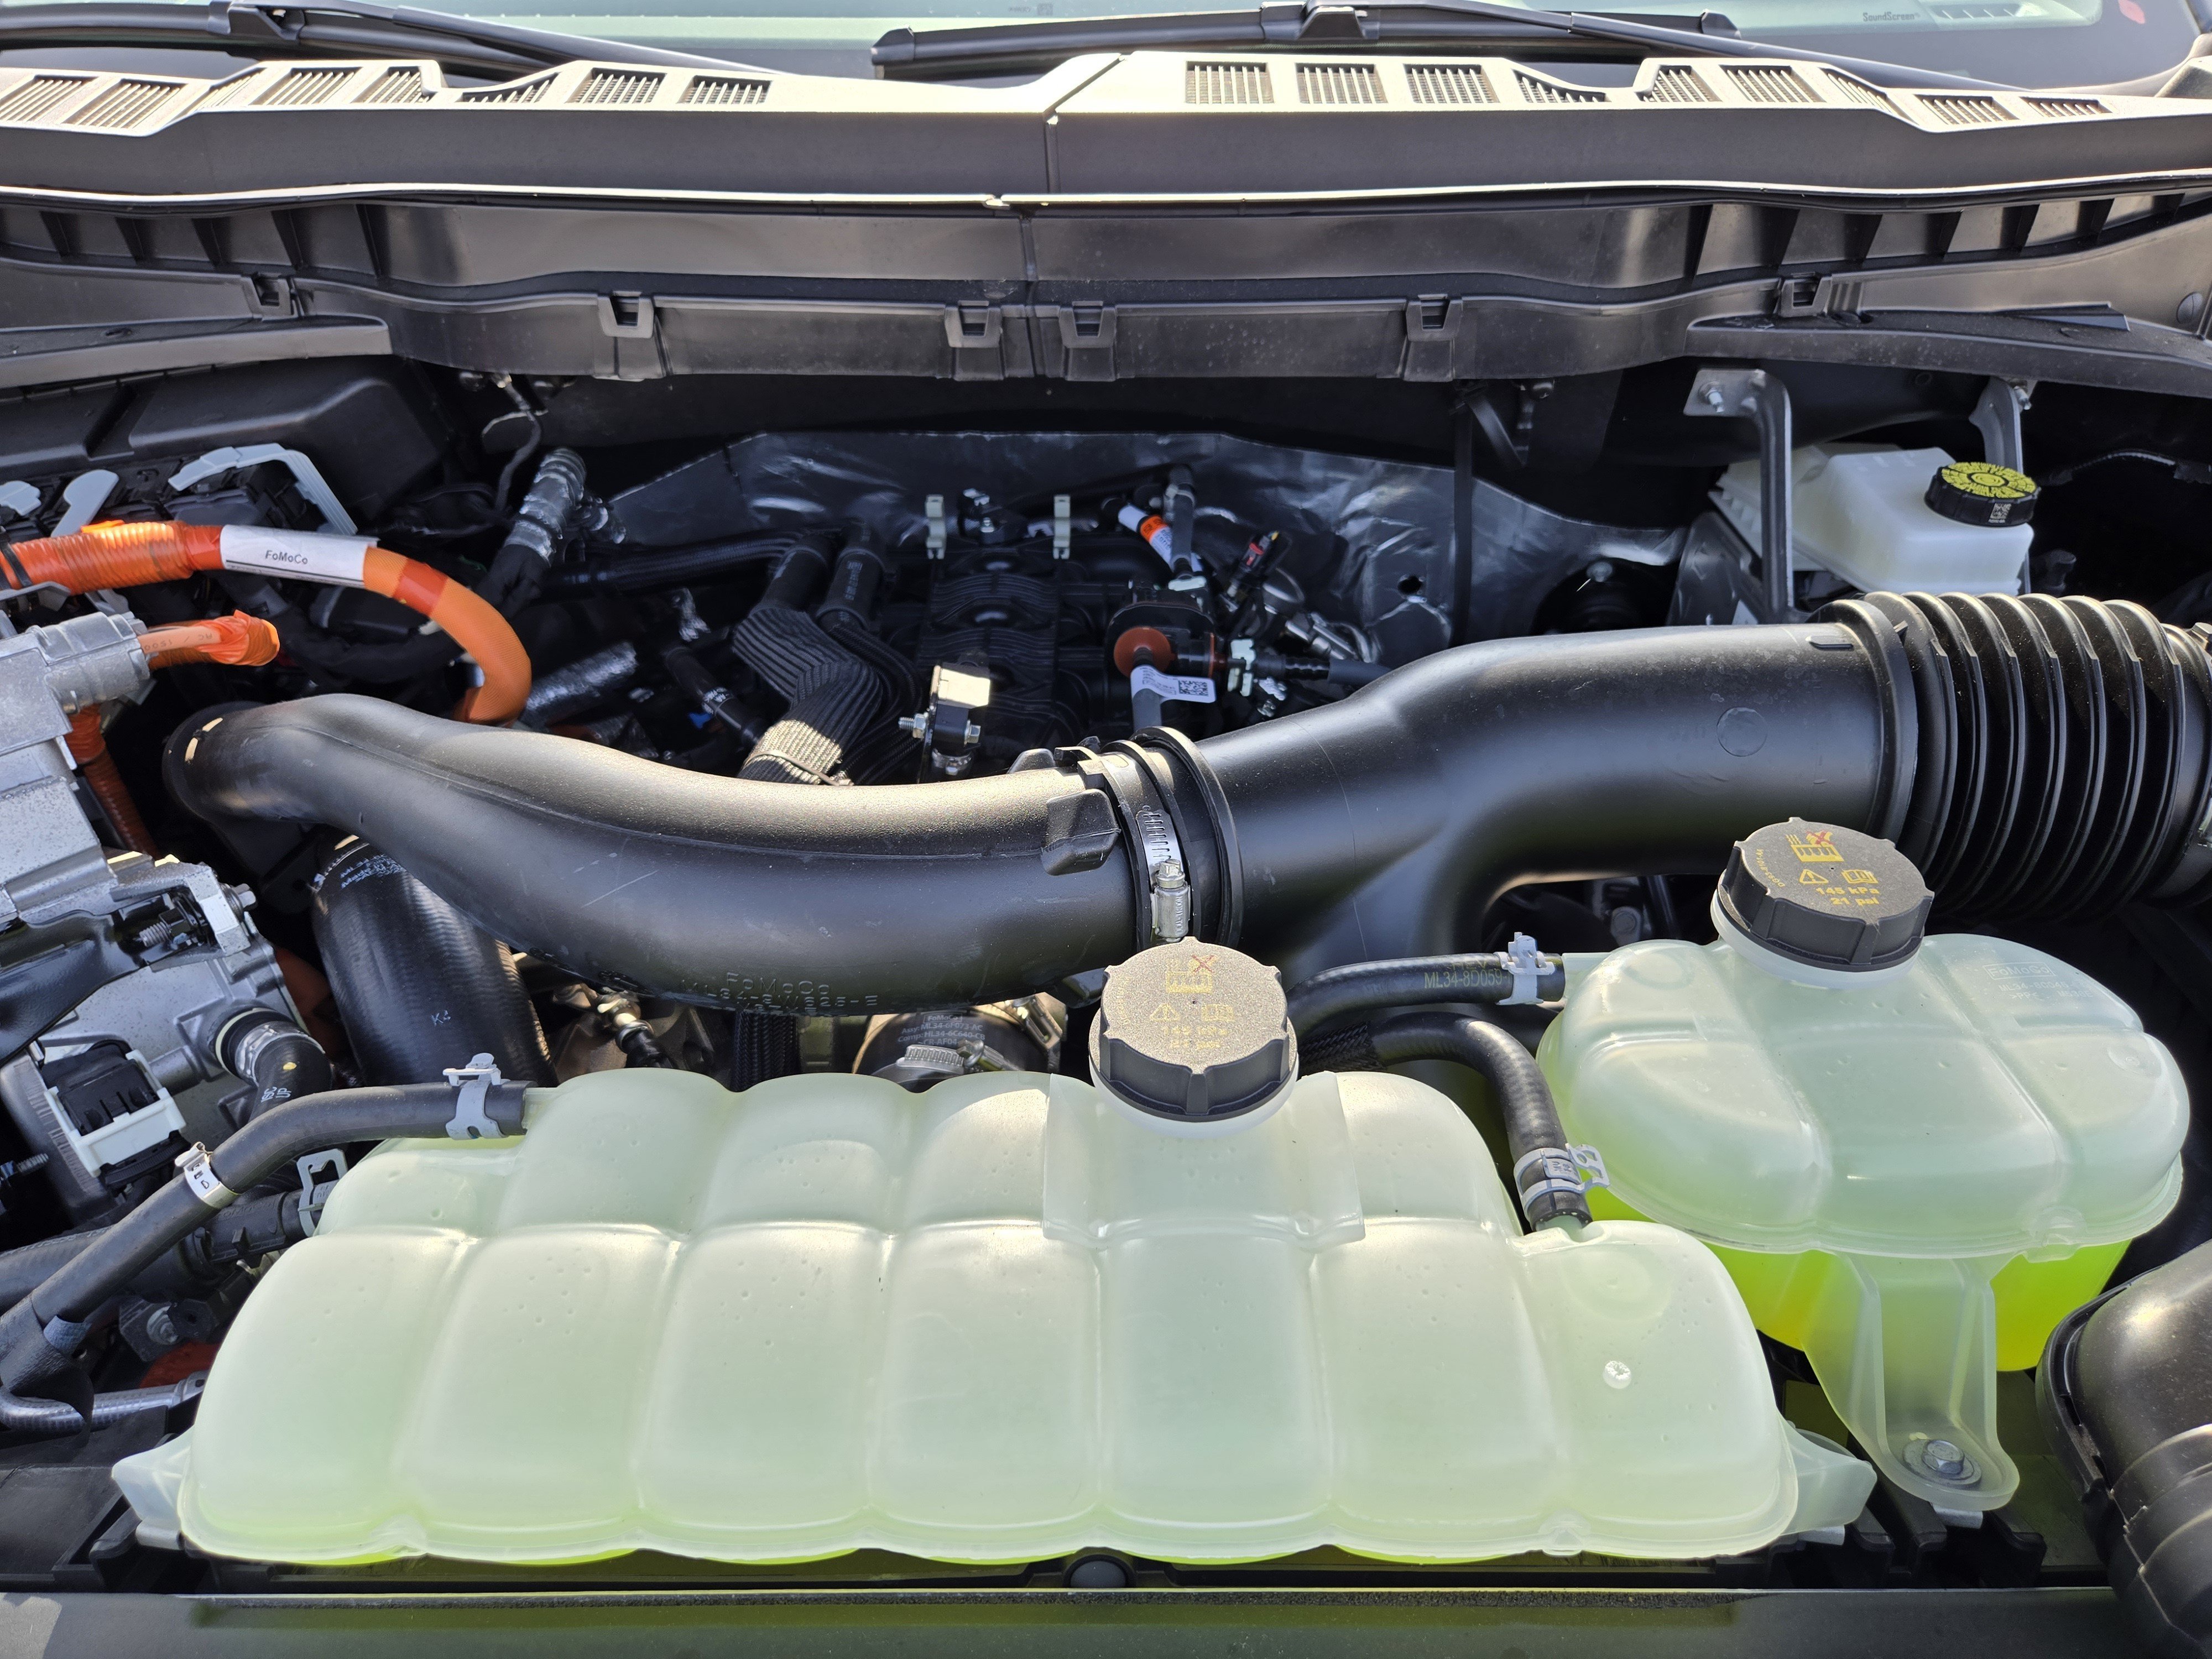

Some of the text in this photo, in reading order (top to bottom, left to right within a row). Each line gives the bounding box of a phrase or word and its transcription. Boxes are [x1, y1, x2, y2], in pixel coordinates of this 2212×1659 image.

[265, 549, 308, 565] FoMoCo
[1855, 897, 1880, 906] psi
[726, 972, 830, 995] FoMoCo
[275, 1087, 292, 1098] UP
